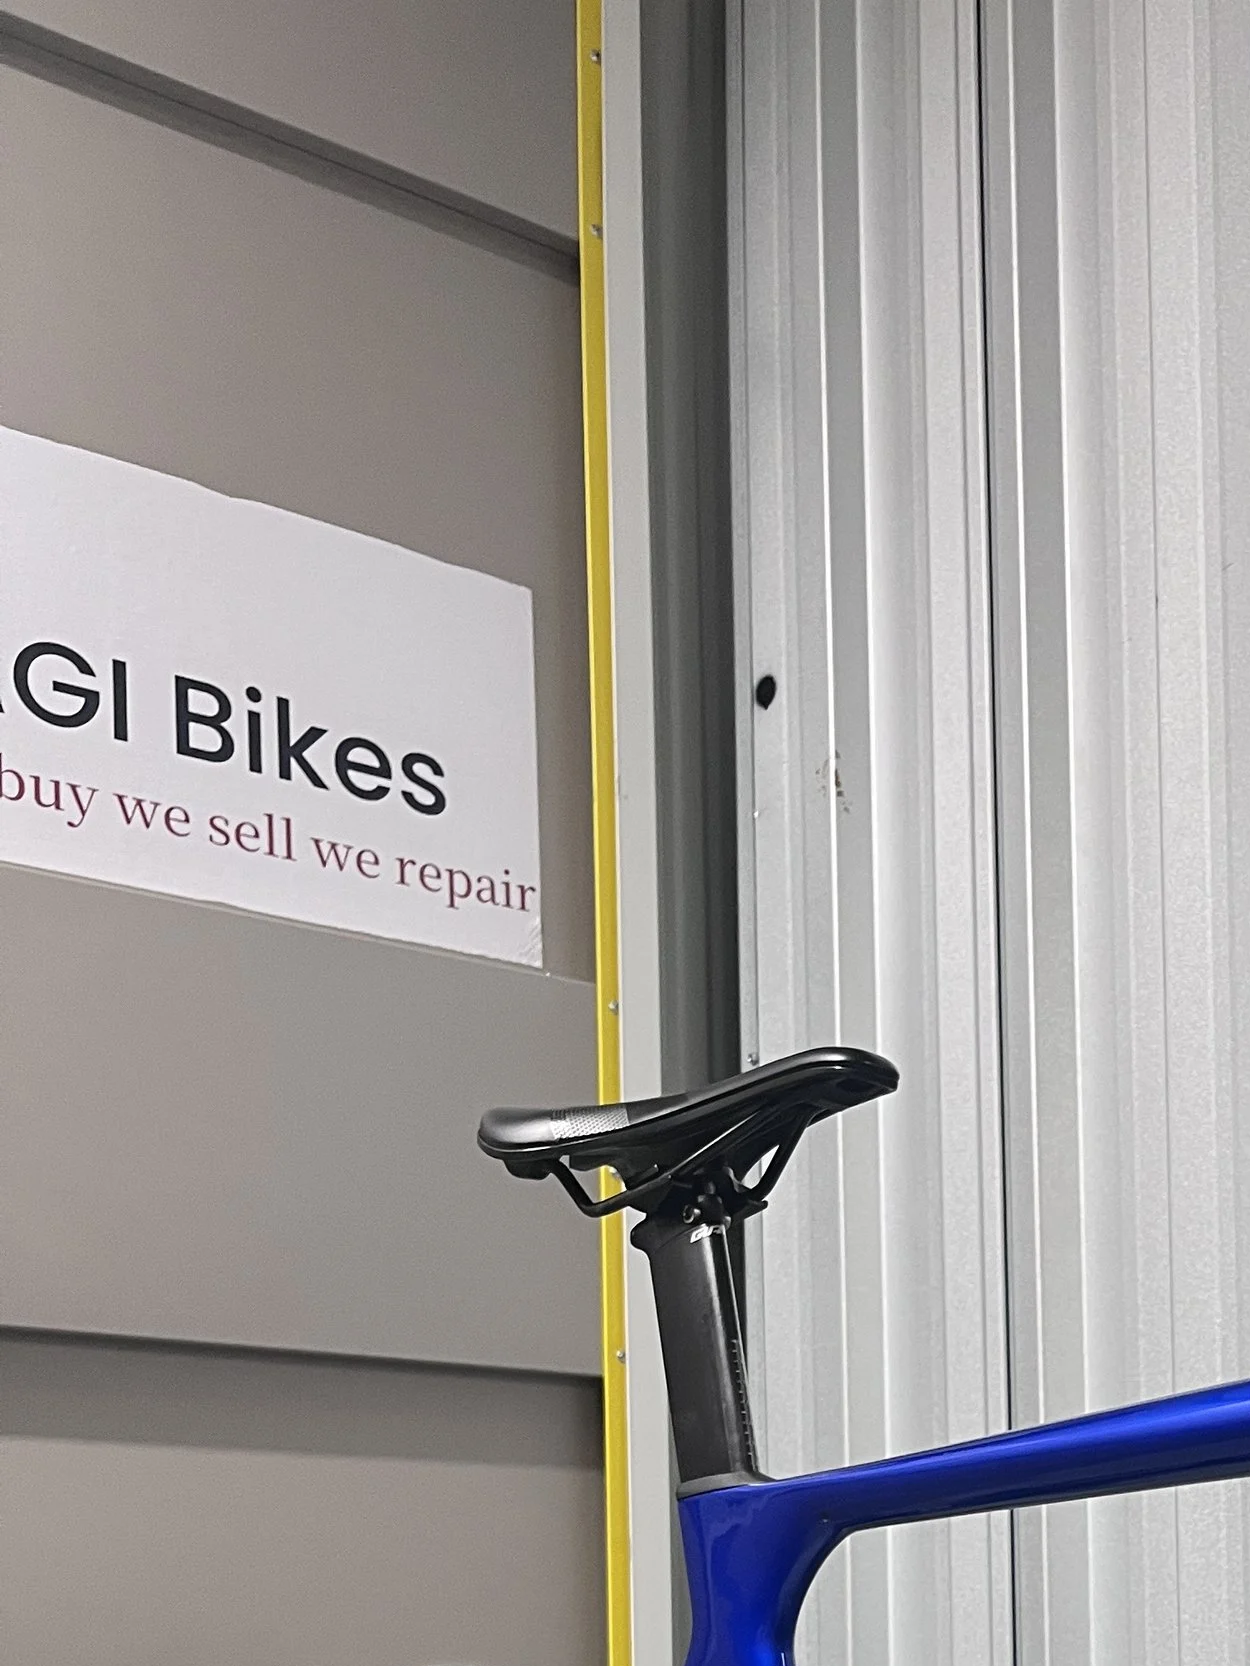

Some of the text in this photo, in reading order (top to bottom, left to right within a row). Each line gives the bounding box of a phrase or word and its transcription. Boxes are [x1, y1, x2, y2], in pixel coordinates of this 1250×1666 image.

[0, 641, 447, 816] GI Bikes
[0, 752, 537, 912] buy we sell we repair
